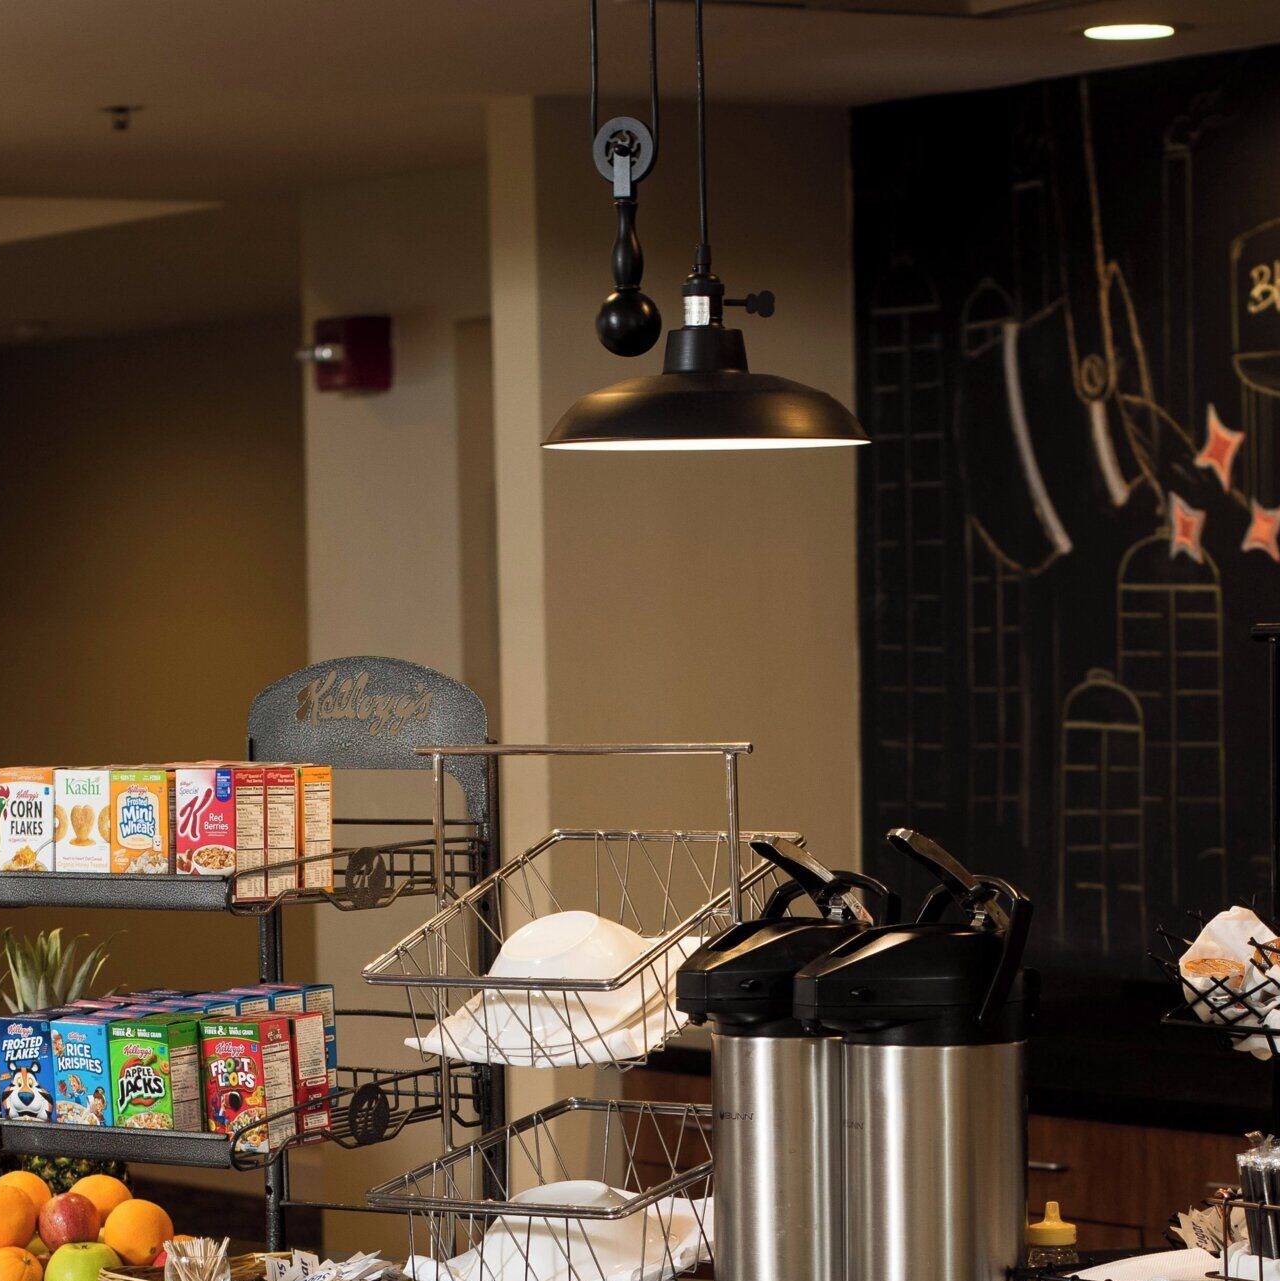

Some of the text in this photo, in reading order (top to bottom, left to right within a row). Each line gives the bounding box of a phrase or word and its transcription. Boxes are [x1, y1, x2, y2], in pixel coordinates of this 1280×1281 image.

[294, 670, 434, 736] Kellogg's
[65, 777, 102, 796] Kashi
[178, 787, 198, 797] Special
[16, 789, 40, 802] Kellogg's
[126, 796, 149, 806] Frosted
[10, 800, 43, 818] CORN
[123, 805, 153, 823] Mini
[179, 787, 213, 838] K
[208, 813, 224, 823] Red
[10, 820, 44, 836] FLAKES
[120, 820, 155, 837] Wheats
[203, 821, 229, 831] Berries
[7, 1023, 34, 1038] Kellogg's
[1, 1036, 43, 1051] FROSTED
[66, 1043, 91, 1058] RICE
[215, 1041, 246, 1057] Kellogg's
[4, 1047, 40, 1061] FLAKES
[123, 1044, 153, 1059] Kellogg's
[57, 1056, 102, 1073] KRISPIES
[210, 1057, 251, 1077] FROOT
[124, 1067, 153, 1078] APPLE
[218, 1072, 256, 1089] LOOPS
[118, 1076, 164, 1109] JACKS
[724, 1111, 754, 1121] BUNN
